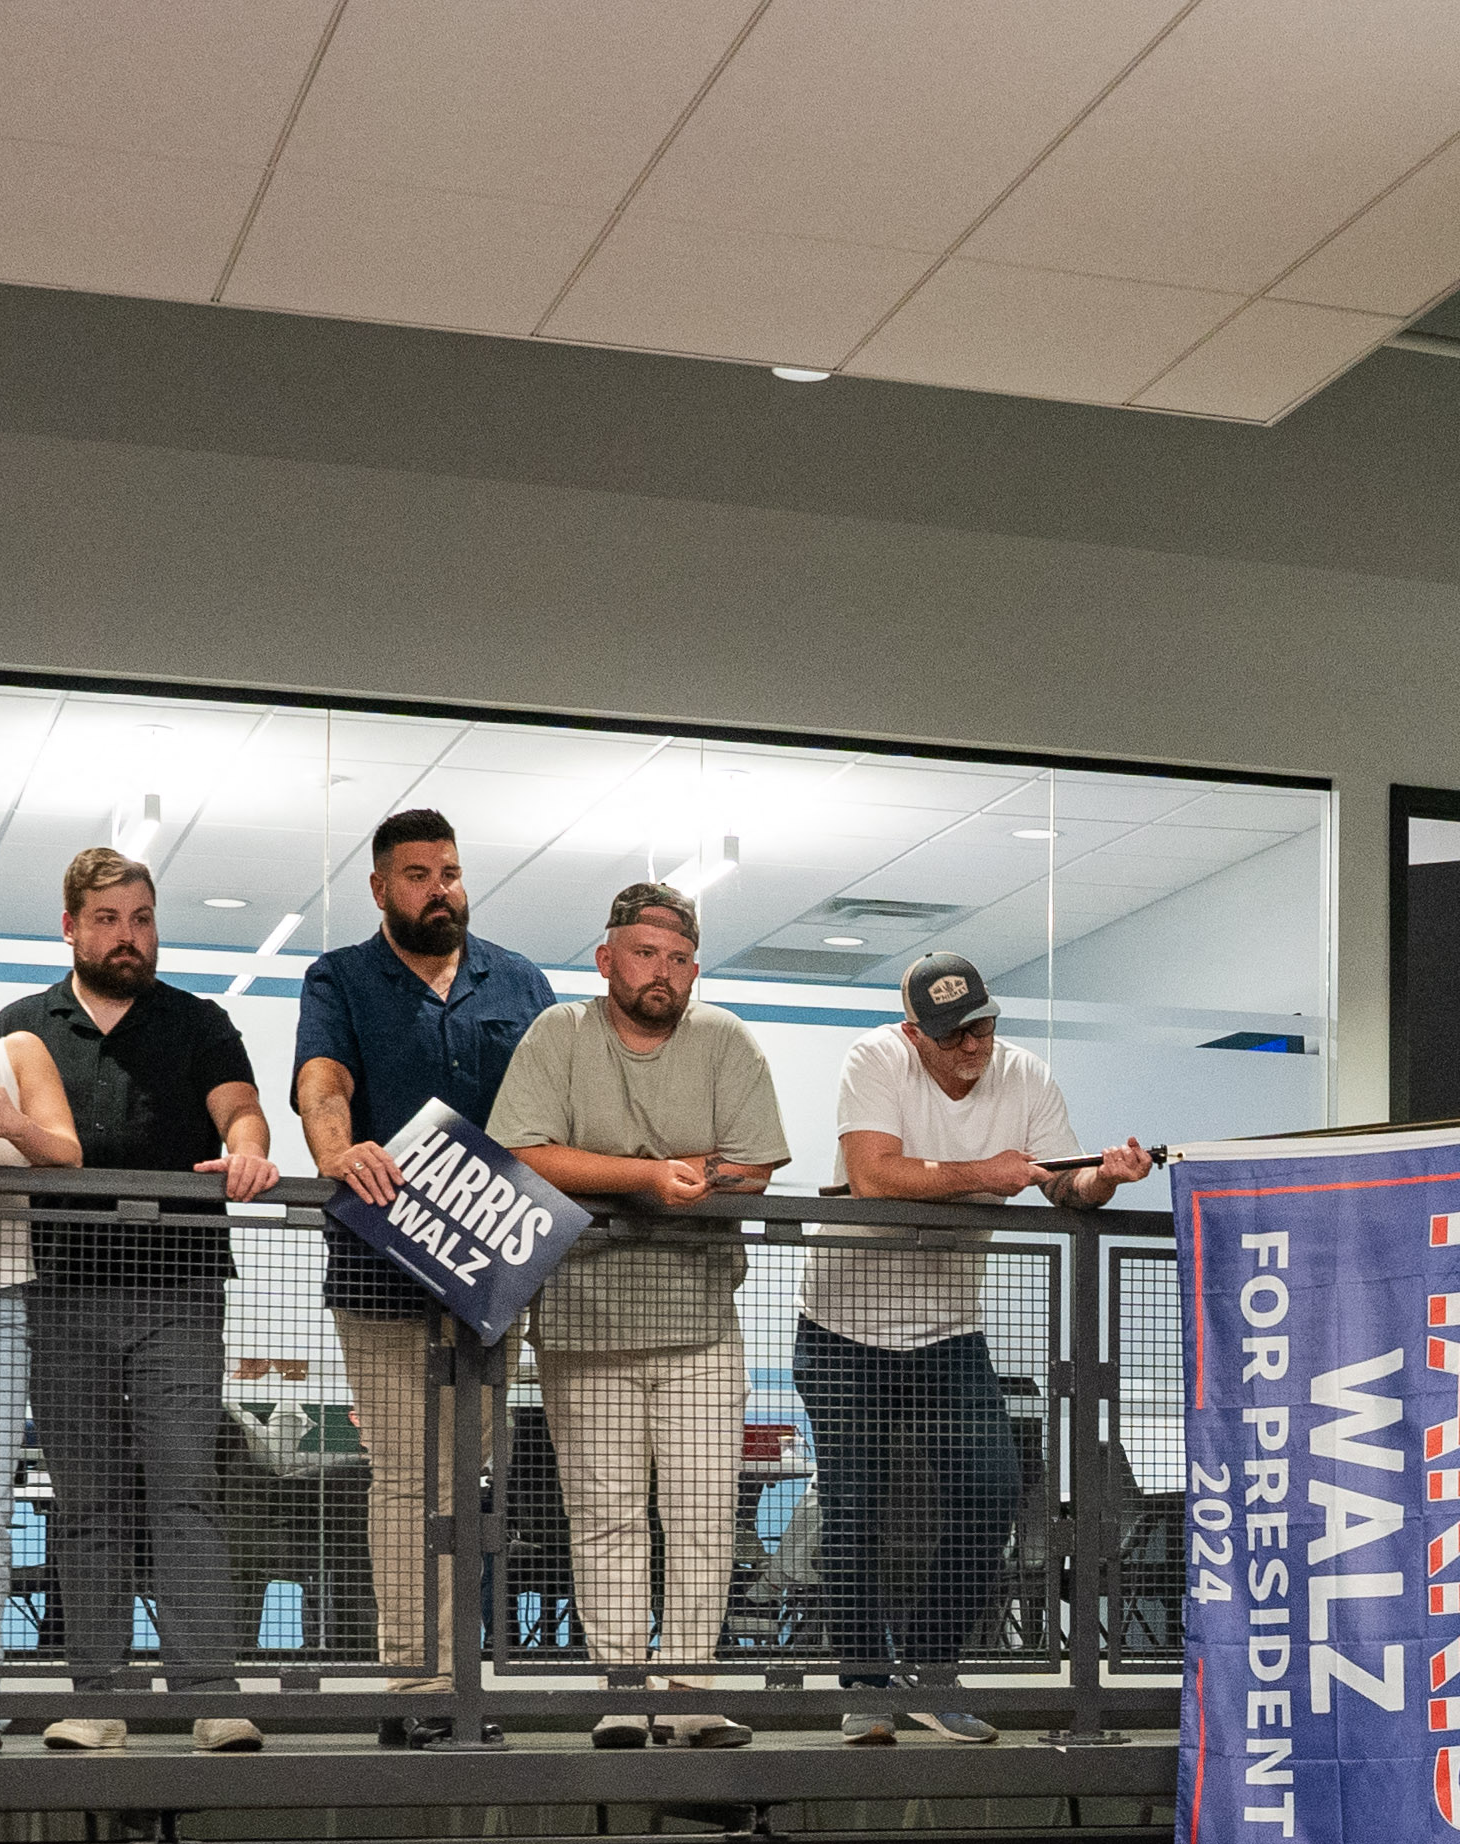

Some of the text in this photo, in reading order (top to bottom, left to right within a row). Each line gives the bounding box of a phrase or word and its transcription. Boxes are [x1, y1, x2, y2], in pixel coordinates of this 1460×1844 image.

[386, 1190, 492, 1288] WALZ
[394, 1124, 554, 1267] HARRIS
[1190, 1462, 1234, 1607] 2024
[1240, 1230, 1297, 1839] FOR PRESIDENT
[1307, 1346, 1407, 1716] WALZ
